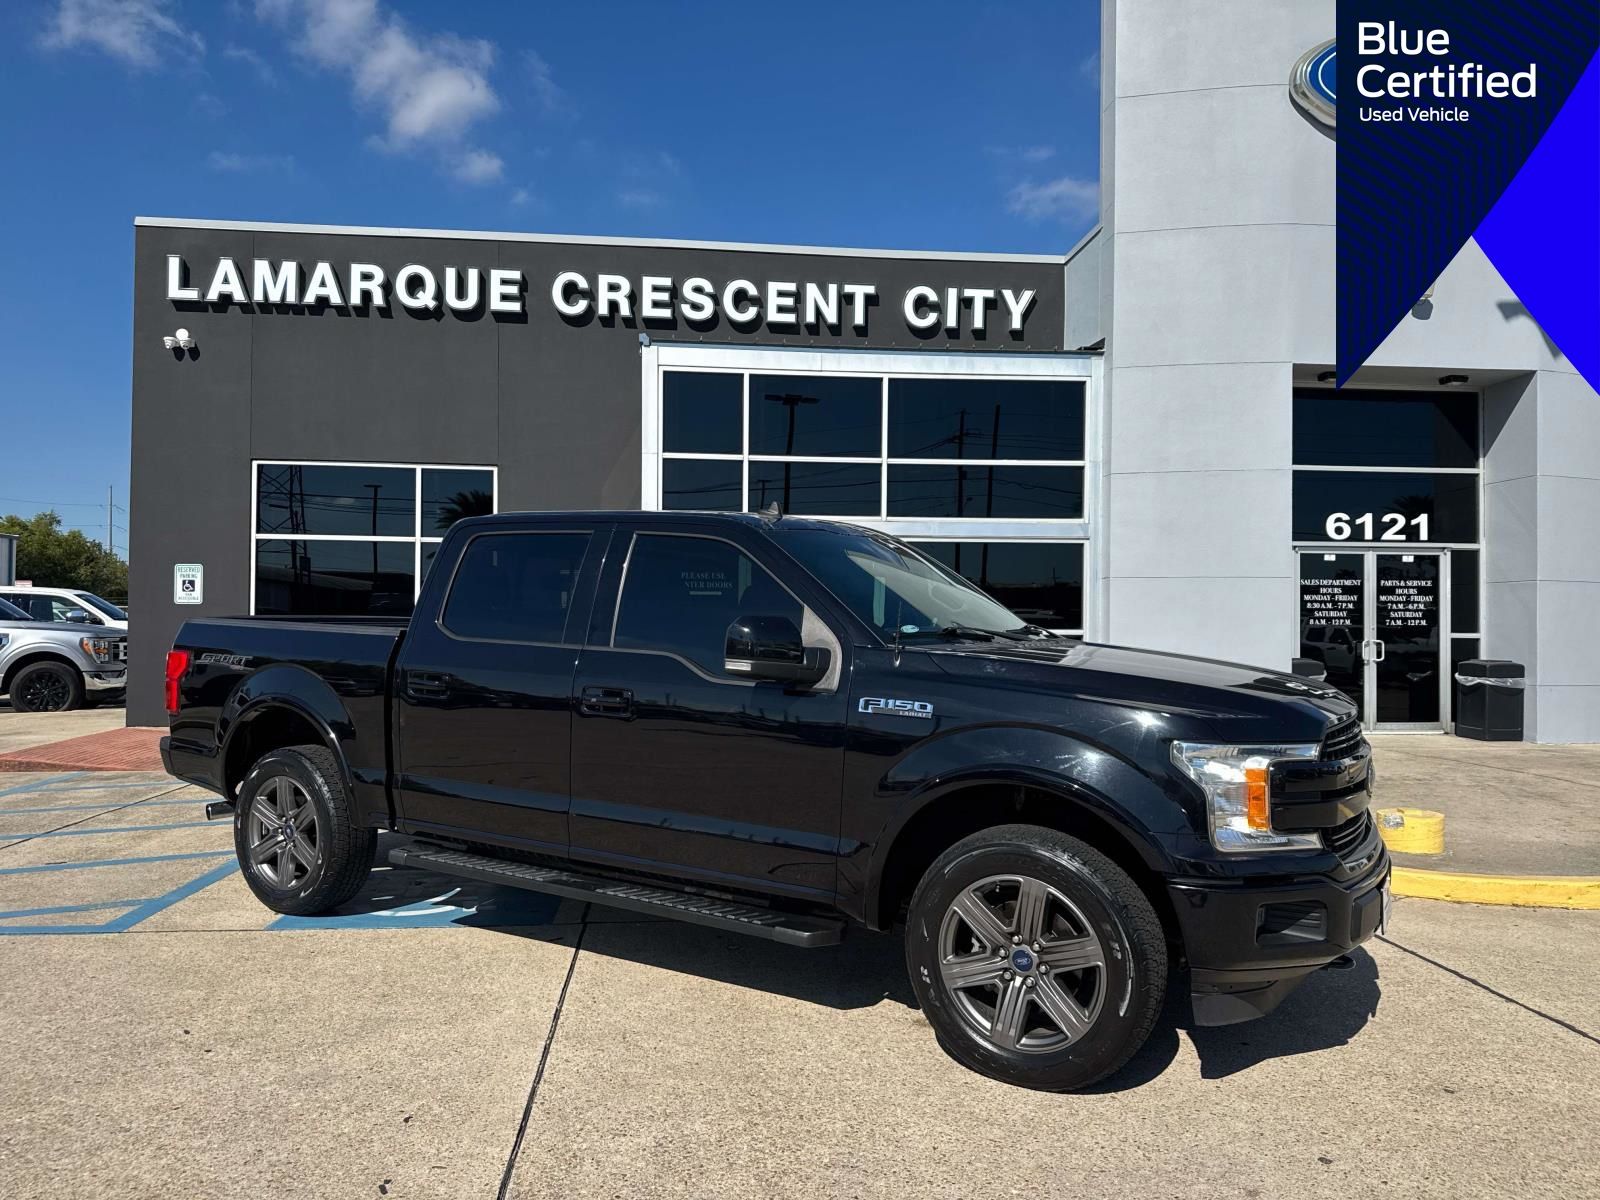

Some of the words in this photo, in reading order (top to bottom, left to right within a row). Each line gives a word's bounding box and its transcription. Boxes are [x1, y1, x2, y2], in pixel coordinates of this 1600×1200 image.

[165, 253, 525, 314] LAMARQUE
[551, 270, 877, 328] CRESCENT
[902, 284, 1037, 332] CITY
[1325, 512, 1429, 541] 6121
